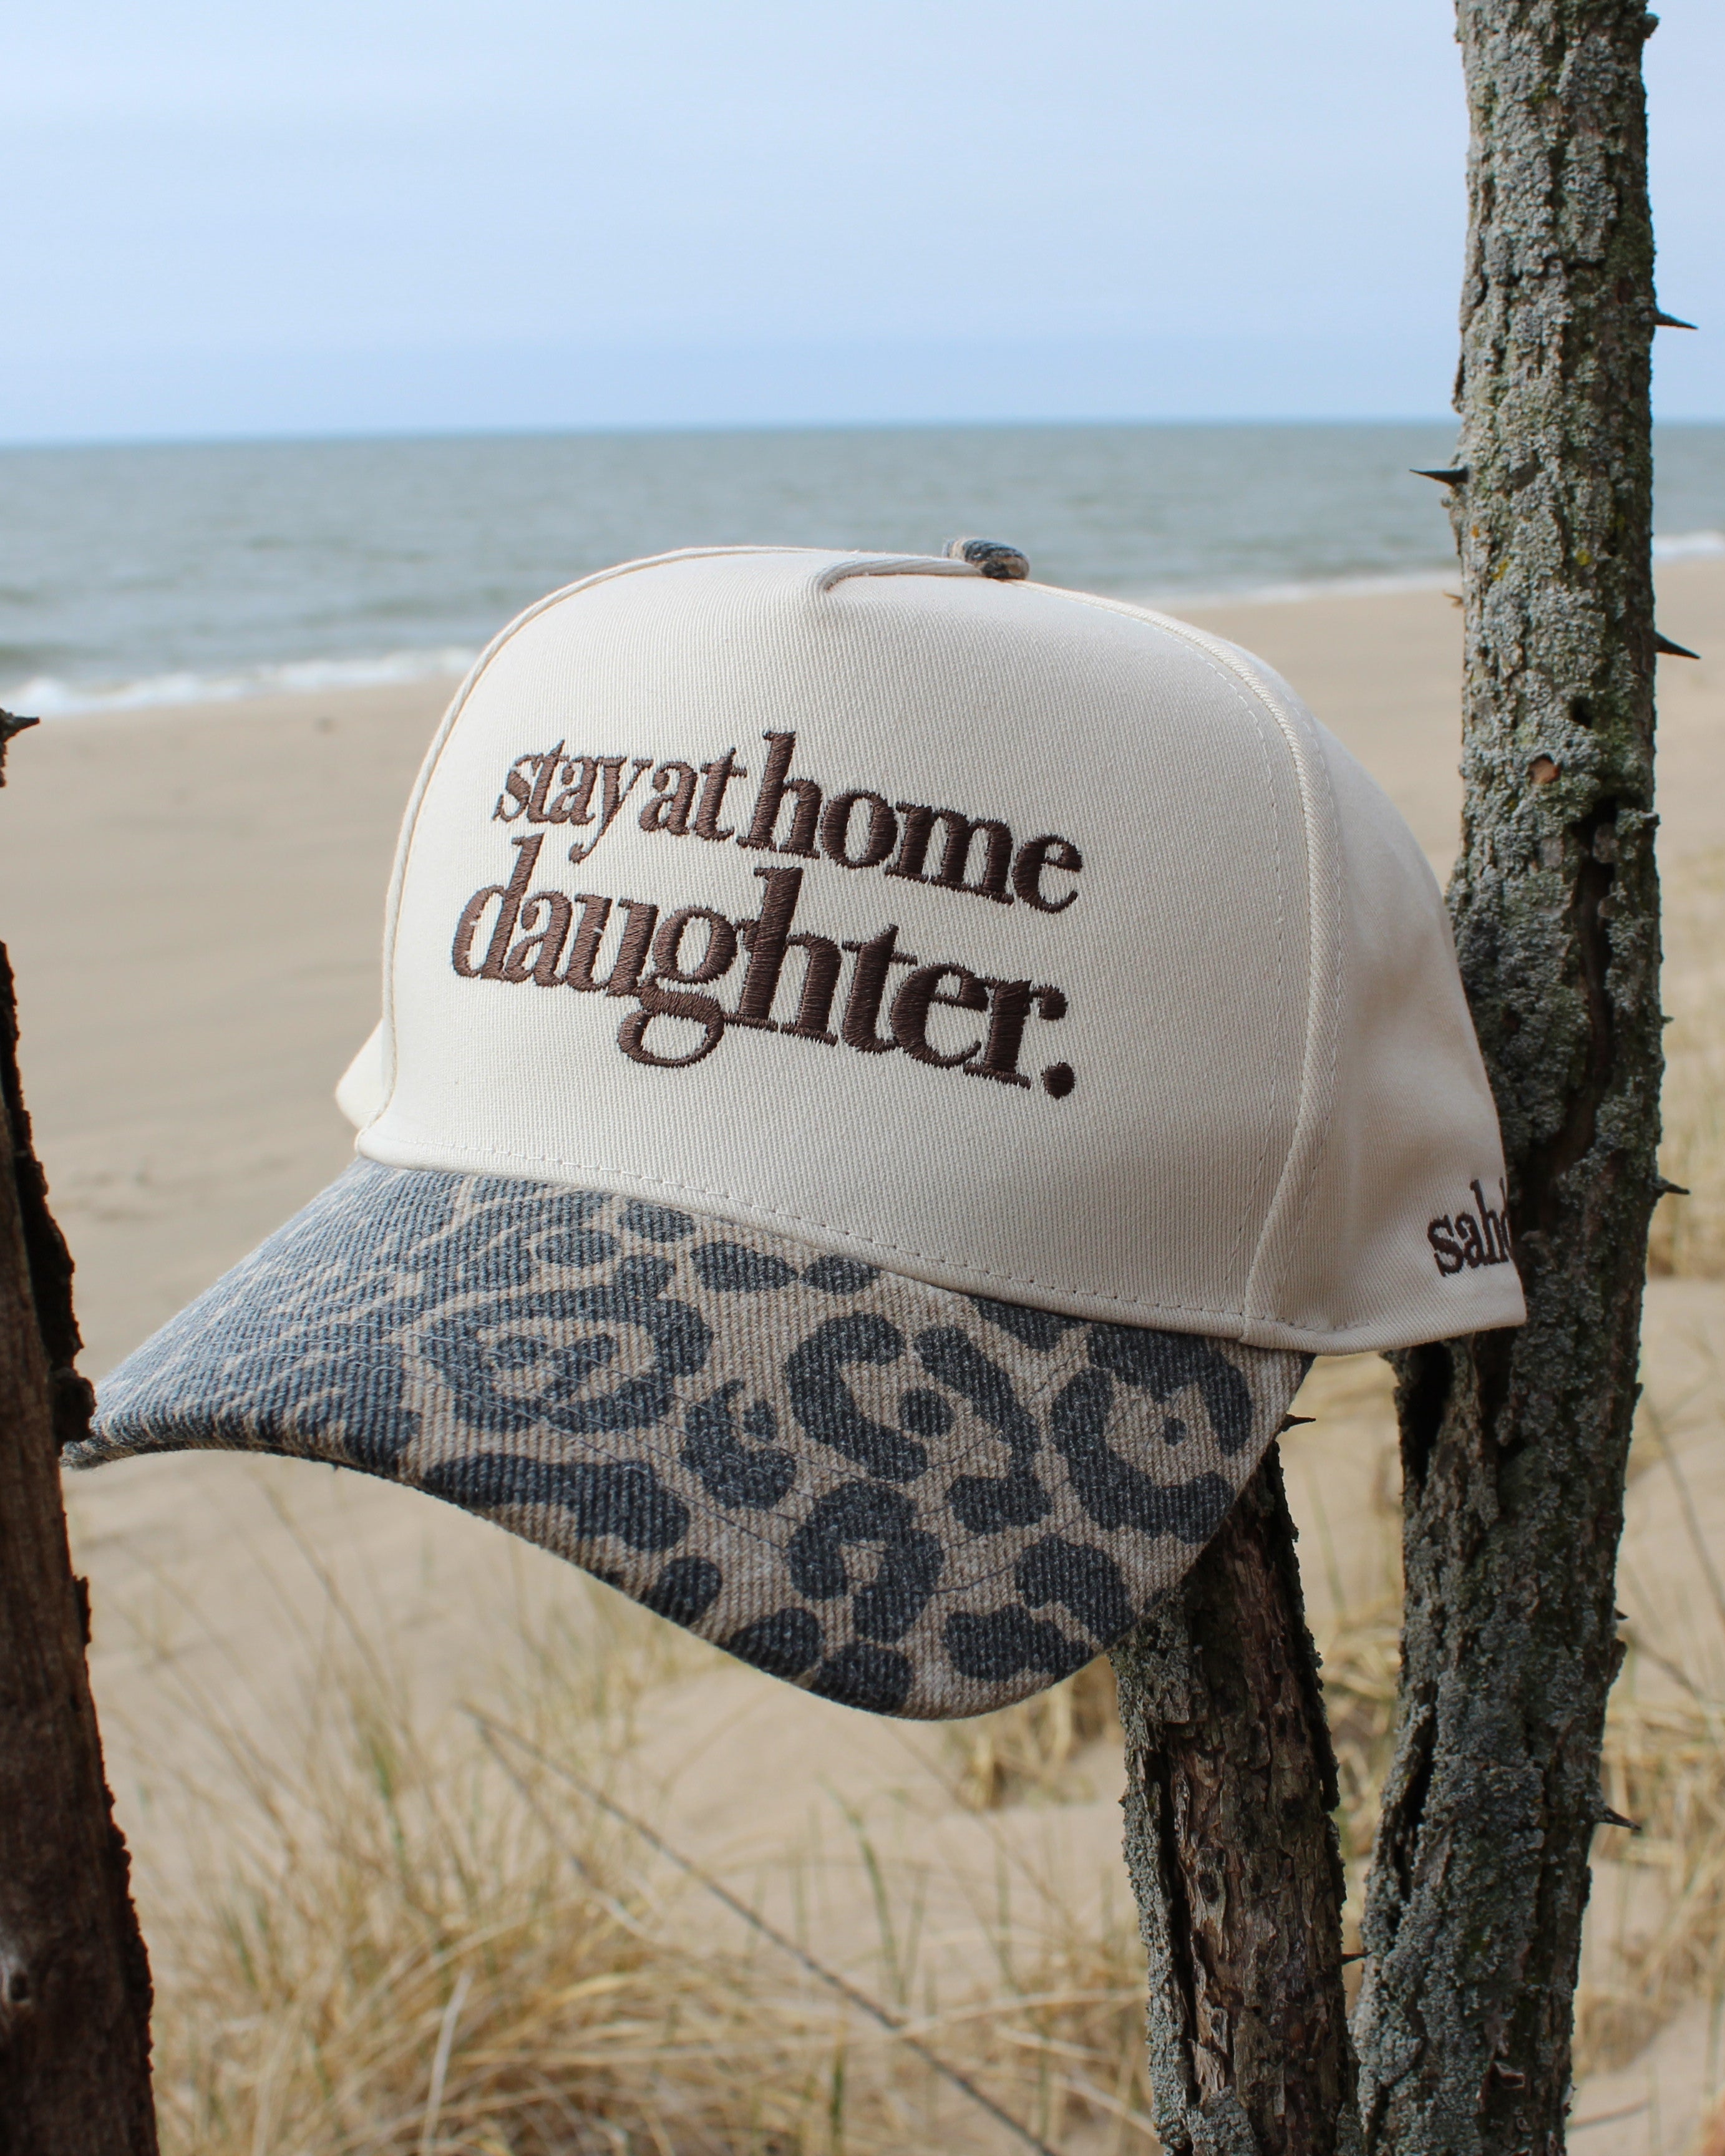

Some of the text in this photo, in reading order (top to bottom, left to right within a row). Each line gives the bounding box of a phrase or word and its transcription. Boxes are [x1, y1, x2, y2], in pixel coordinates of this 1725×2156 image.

[491, 730, 1083, 913] stay at home
[452, 832, 1077, 1099] daughter.
